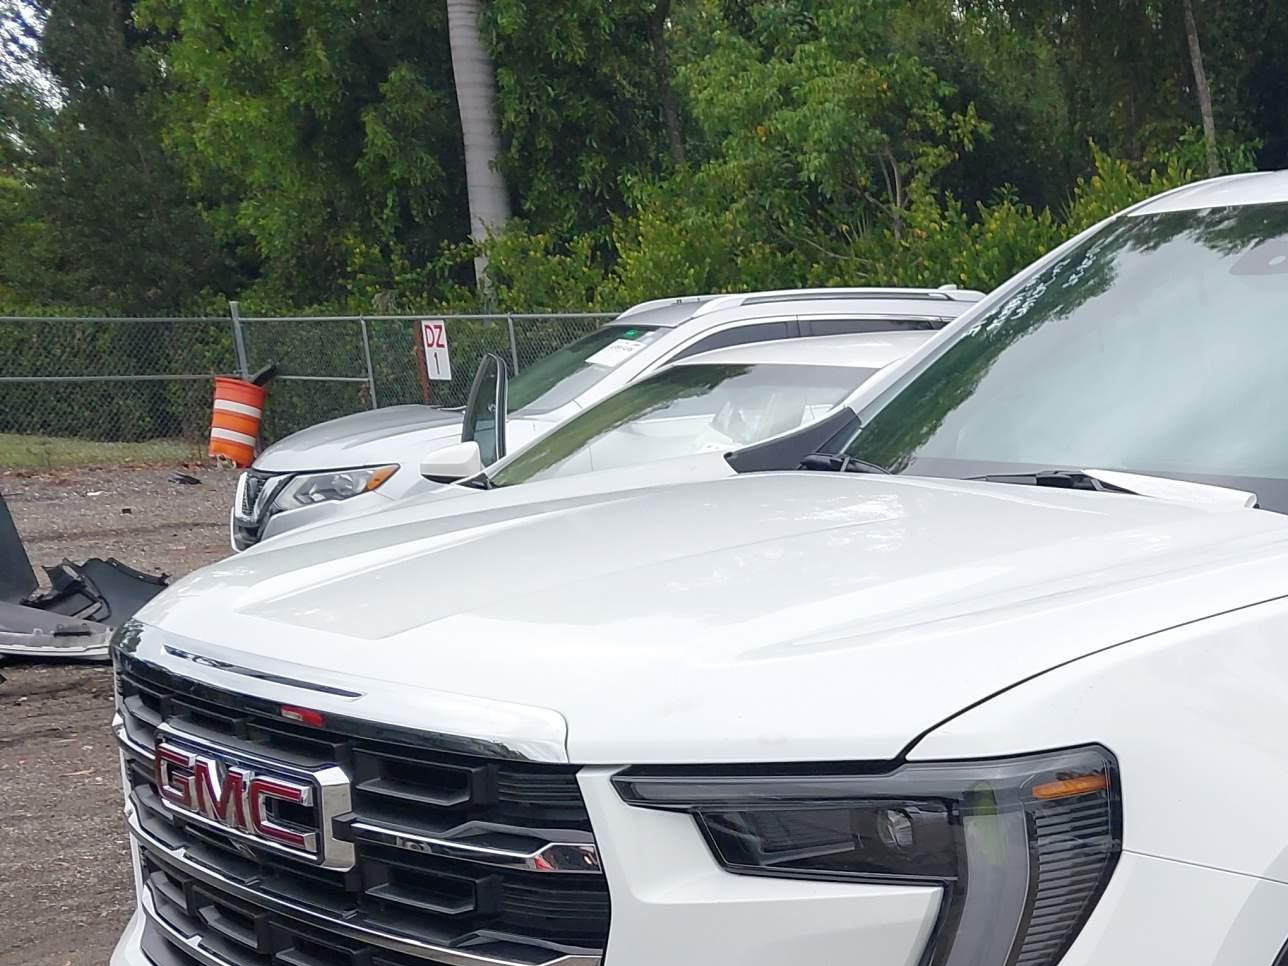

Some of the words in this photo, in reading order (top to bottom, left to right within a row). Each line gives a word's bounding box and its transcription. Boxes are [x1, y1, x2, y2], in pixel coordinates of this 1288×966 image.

[424, 324, 446, 349] DZ
[433, 351, 441, 376] 1
[154, 741, 318, 854] GMC
